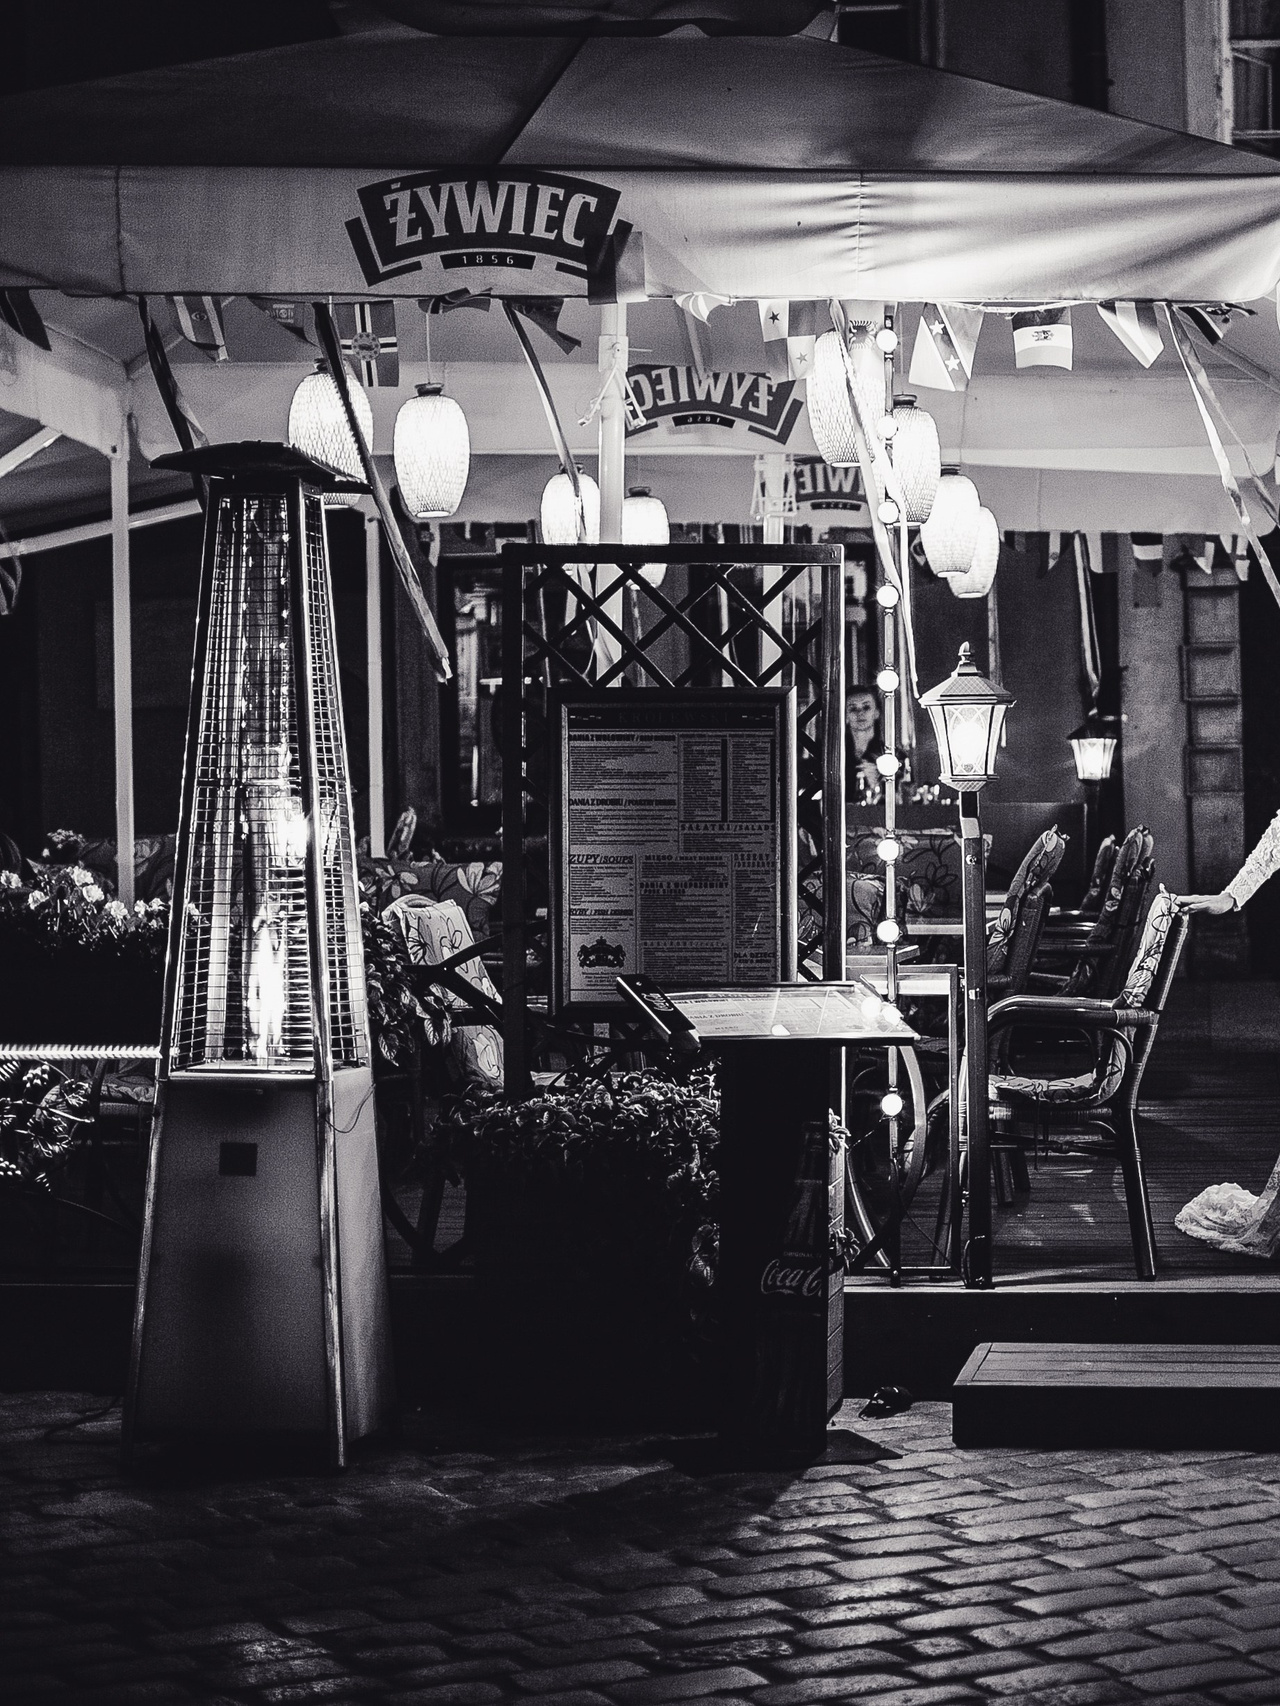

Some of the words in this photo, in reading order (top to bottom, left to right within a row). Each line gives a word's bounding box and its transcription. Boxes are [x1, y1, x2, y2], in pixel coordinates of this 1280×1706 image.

[383, 181, 598, 247] ŻYWIEC
[462, 255, 514, 264] 1856
[569, 854, 600, 864] ZUPY
